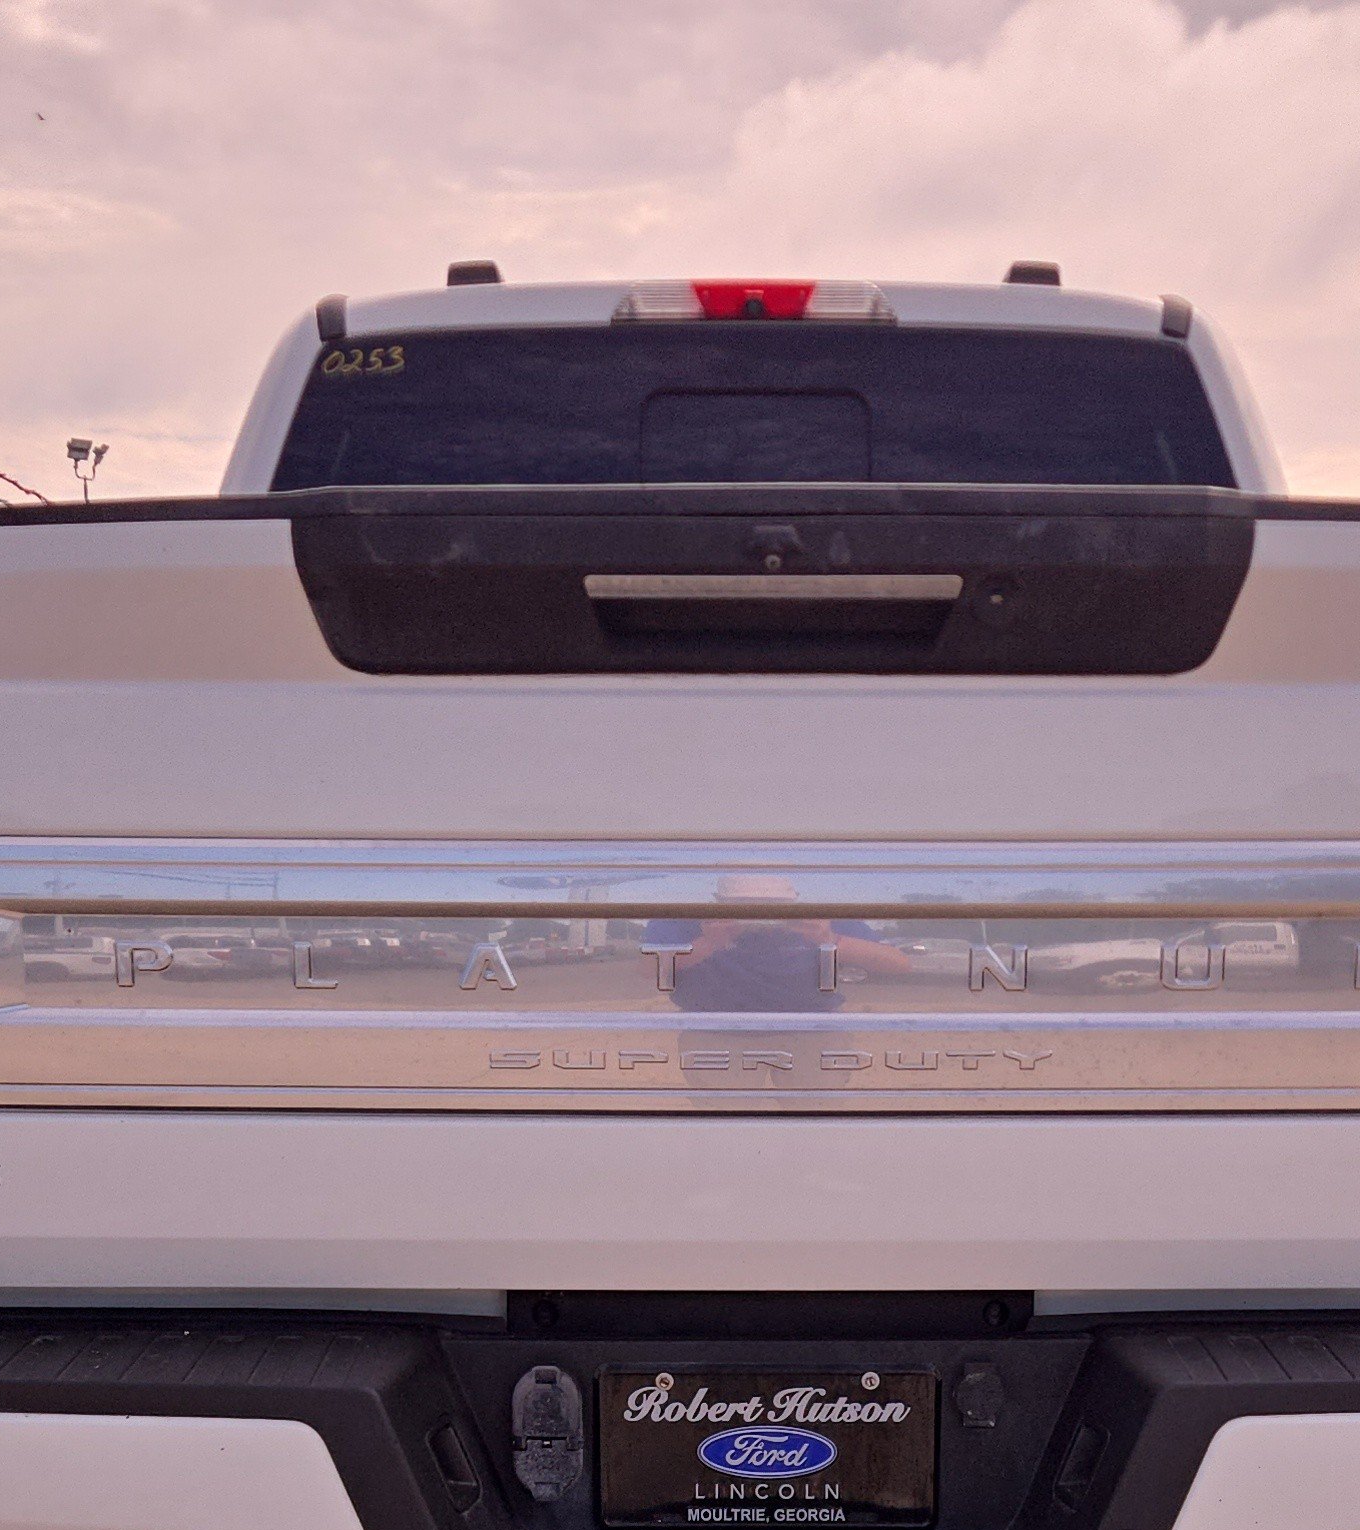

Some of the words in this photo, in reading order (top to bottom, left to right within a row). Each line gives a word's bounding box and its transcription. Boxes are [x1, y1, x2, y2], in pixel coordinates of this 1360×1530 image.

[489, 1049, 794, 1071] SUPER
[819, 1049, 1053, 1071] DUTY
[623, 1386, 765, 1423] Robert
[766, 1387, 911, 1423] Hutson
[725, 1434, 809, 1467] Ford
[695, 1483, 841, 1500] LINCOLN
[687, 1508, 770, 1523] MOULTRIE,
[774, 1508, 846, 1522] GEORGIA
